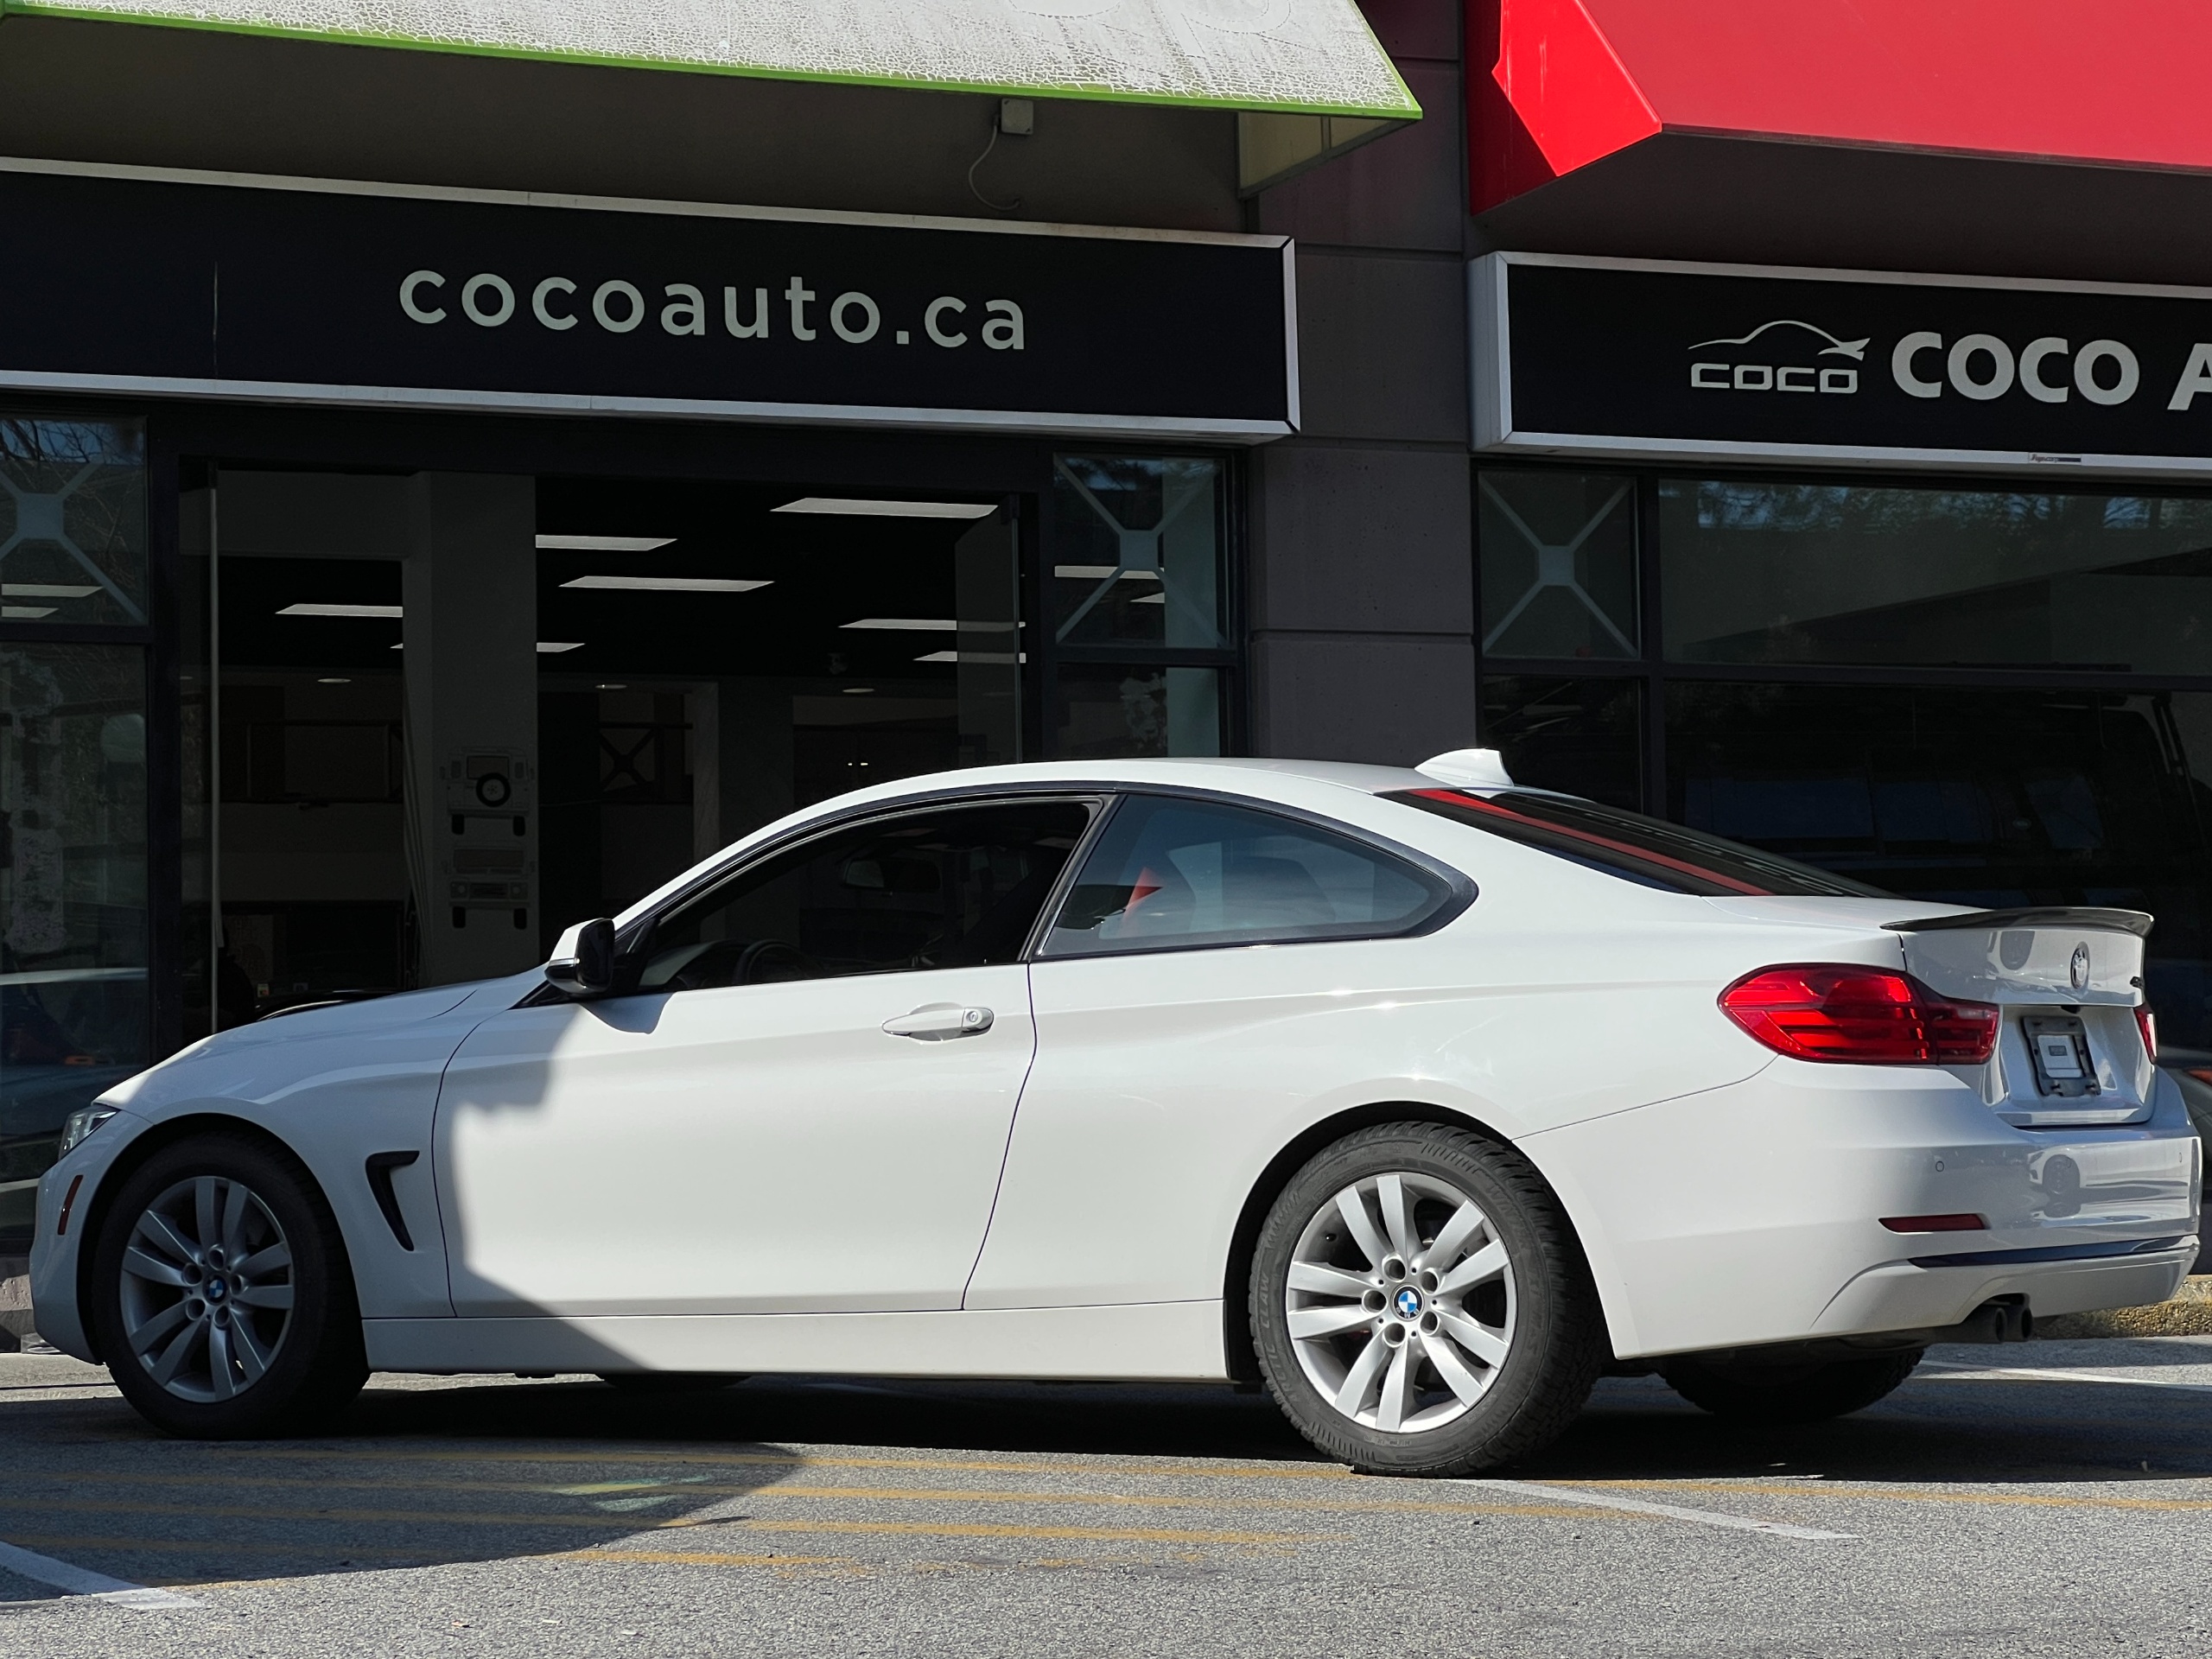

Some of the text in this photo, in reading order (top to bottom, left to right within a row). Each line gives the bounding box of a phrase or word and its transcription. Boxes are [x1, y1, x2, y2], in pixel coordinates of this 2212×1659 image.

[399, 270, 1024, 350] cocoauto.ca
[1691, 363, 1858, 394] COCO
[1891, 331, 2212, 410] COCO A
[1259, 1272, 1270, 1330] CLAW
